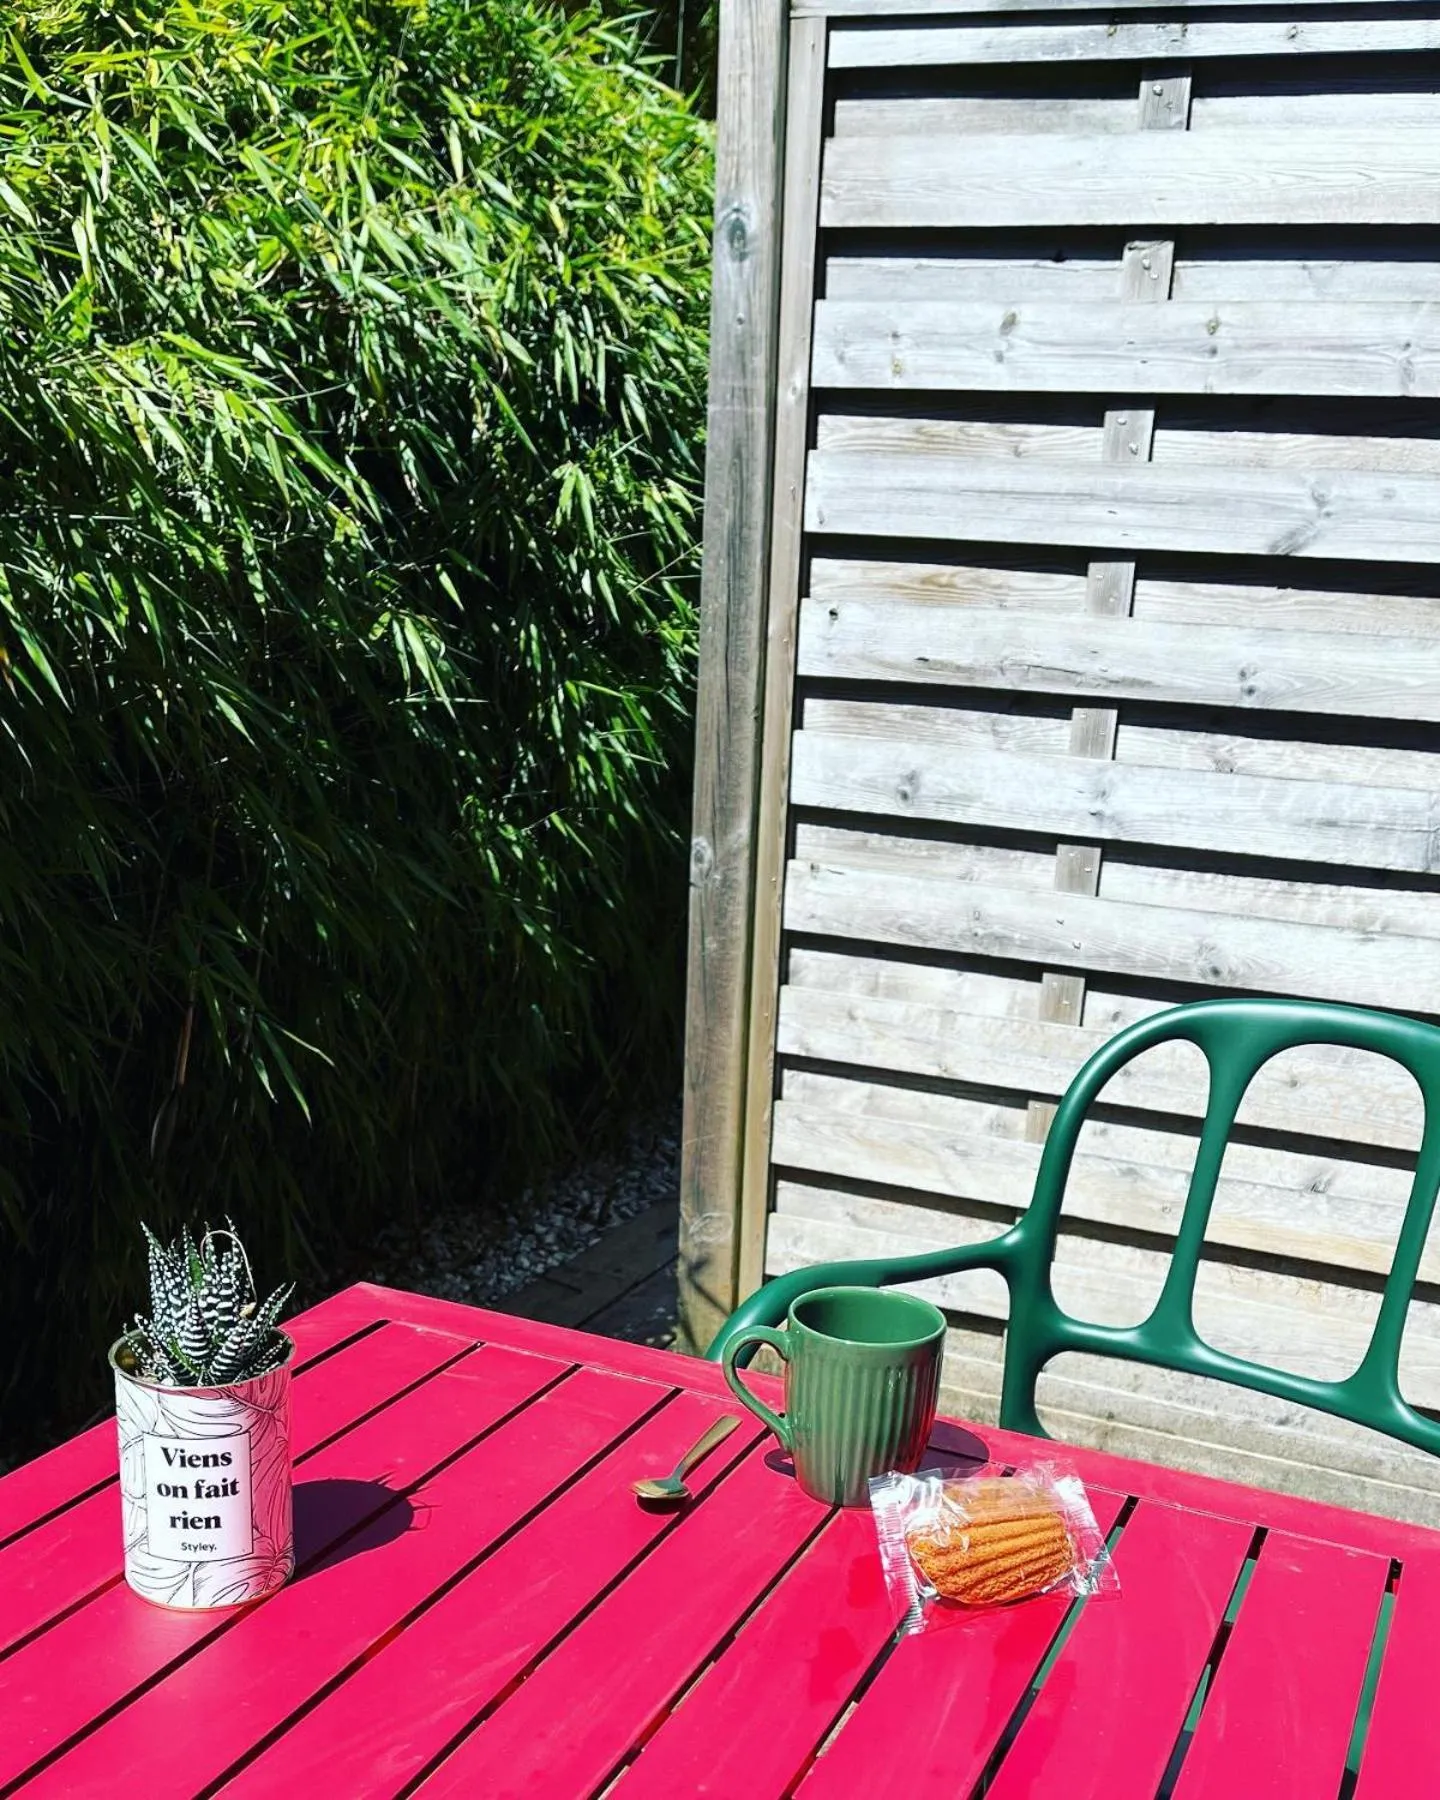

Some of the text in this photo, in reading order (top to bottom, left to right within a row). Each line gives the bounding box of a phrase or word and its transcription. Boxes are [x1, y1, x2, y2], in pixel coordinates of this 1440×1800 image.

[161, 1446, 232, 1468] Viens
[157, 1477, 240, 1499] on fait
[170, 1510, 222, 1530] rien
[180, 1541, 217, 1553] Styley.
